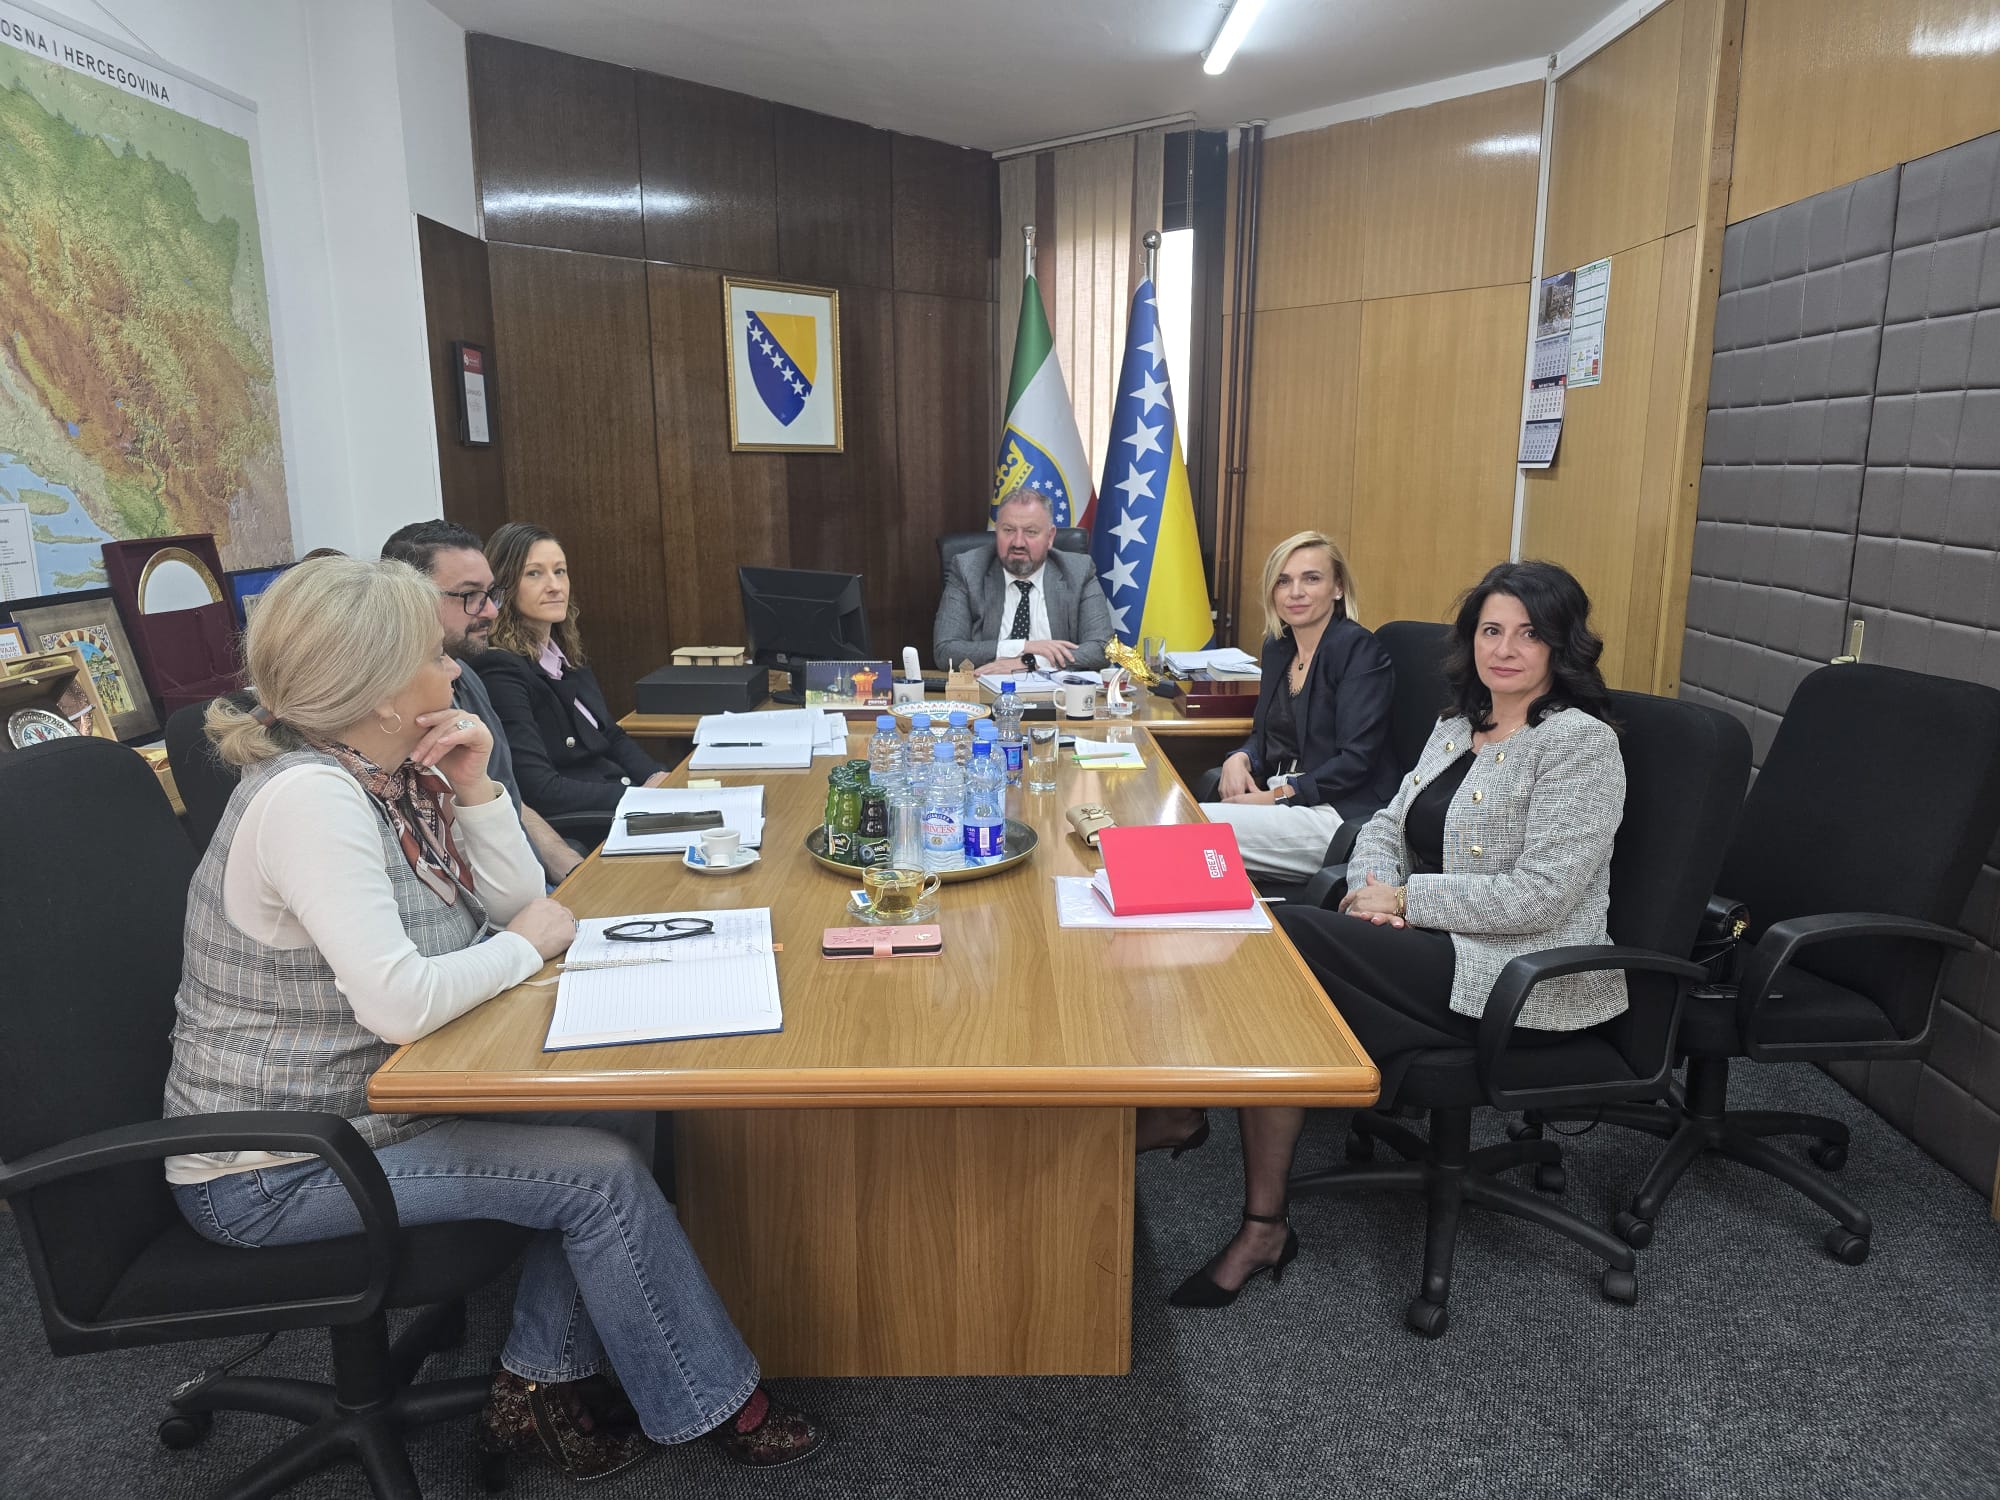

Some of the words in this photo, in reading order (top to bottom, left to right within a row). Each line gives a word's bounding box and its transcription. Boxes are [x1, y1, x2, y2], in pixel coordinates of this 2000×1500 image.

[53, 40, 58, 57] I
[64, 45, 170, 102] HERCEGOVINA
[922, 824, 956, 833] INCESS
[1205, 850, 1219, 876] GREAT
